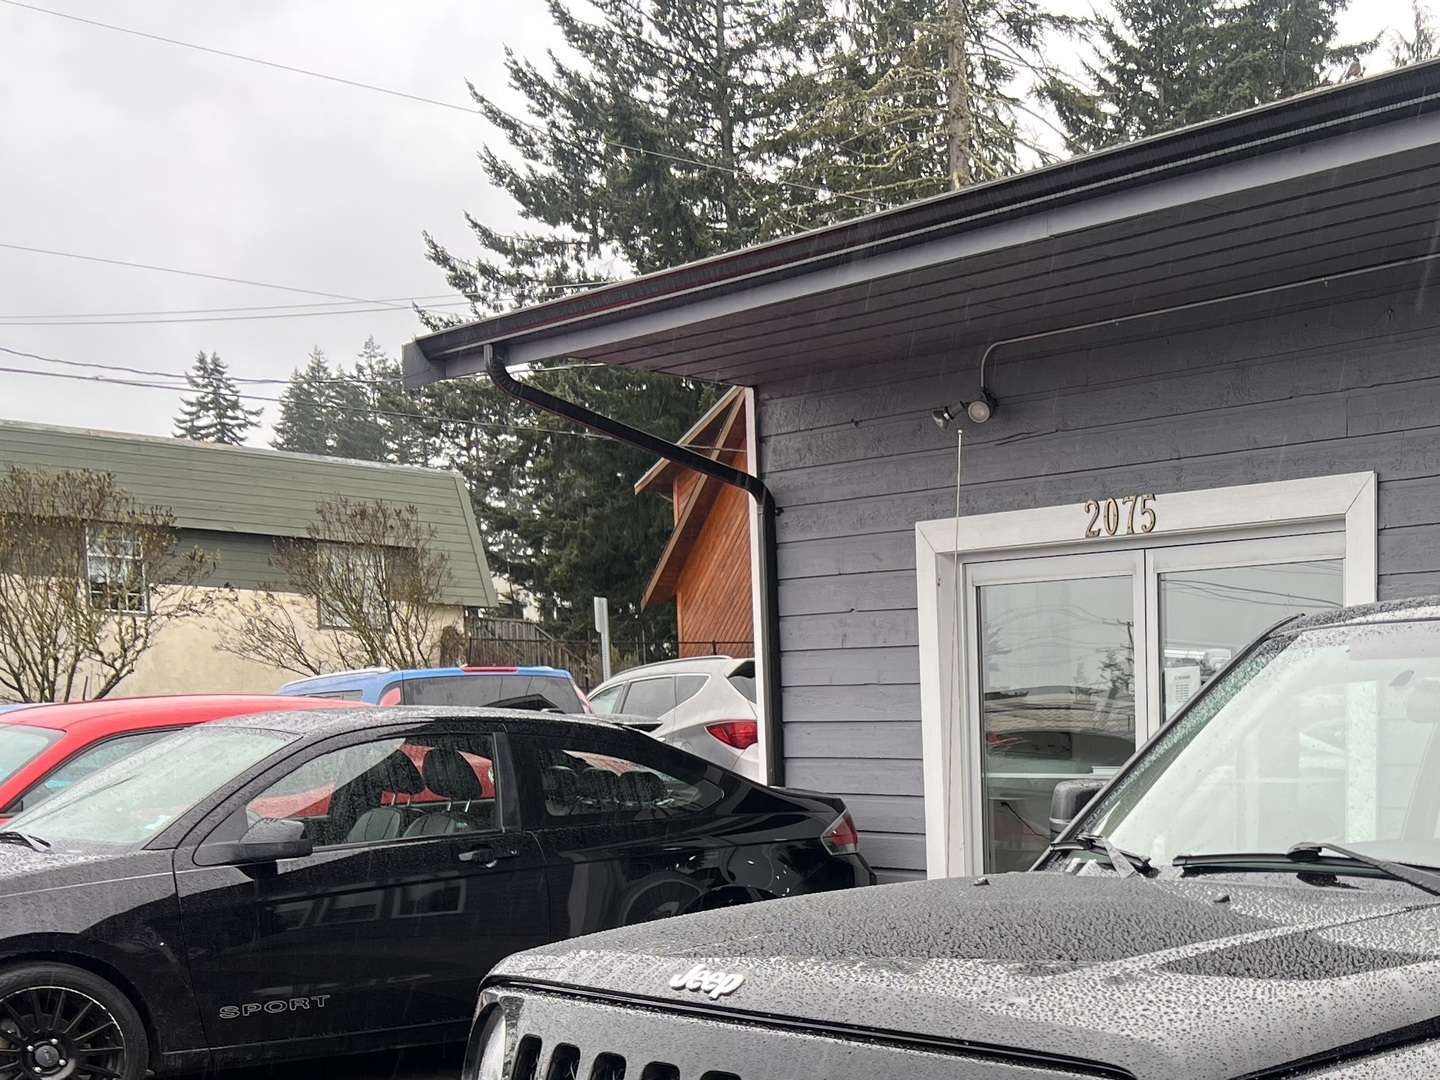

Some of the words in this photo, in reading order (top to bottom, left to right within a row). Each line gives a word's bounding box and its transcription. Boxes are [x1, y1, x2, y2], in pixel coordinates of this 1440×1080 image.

[1084, 493, 1157, 537] 2075
[669, 964, 745, 1001] Jeep
[219, 994, 331, 1019] SPORT
